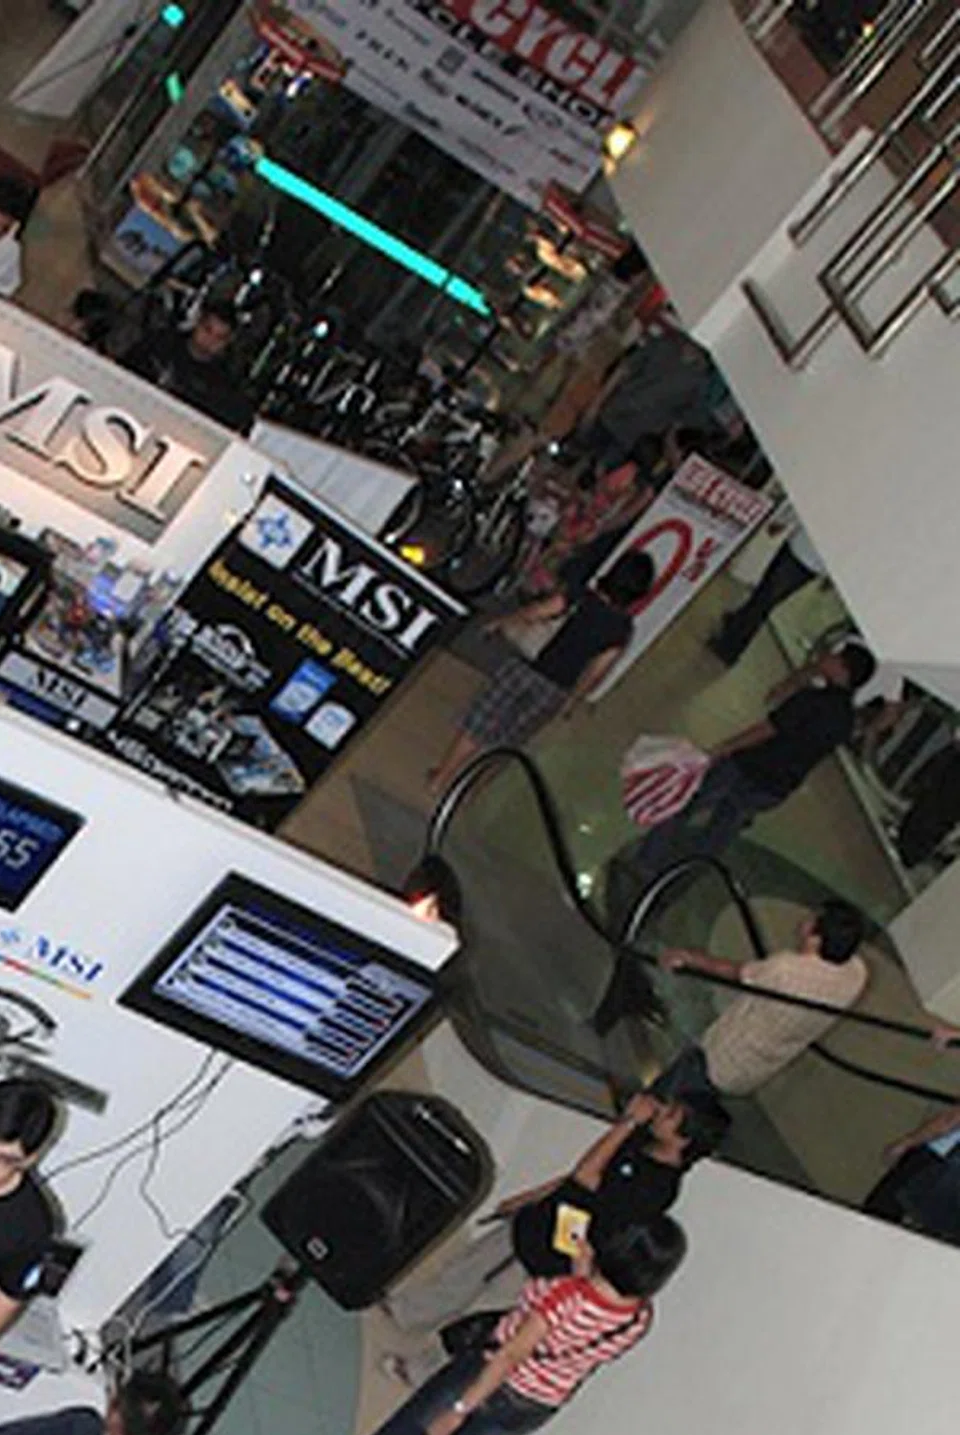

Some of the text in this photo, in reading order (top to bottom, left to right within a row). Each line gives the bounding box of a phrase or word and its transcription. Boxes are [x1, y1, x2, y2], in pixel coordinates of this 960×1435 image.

[208, 558, 269, 610] Insist
[266, 603, 297, 631] on
[296, 623, 333, 656] the
[300, 537, 438, 649] MSI
[26, 935, 104, 981] MSI
